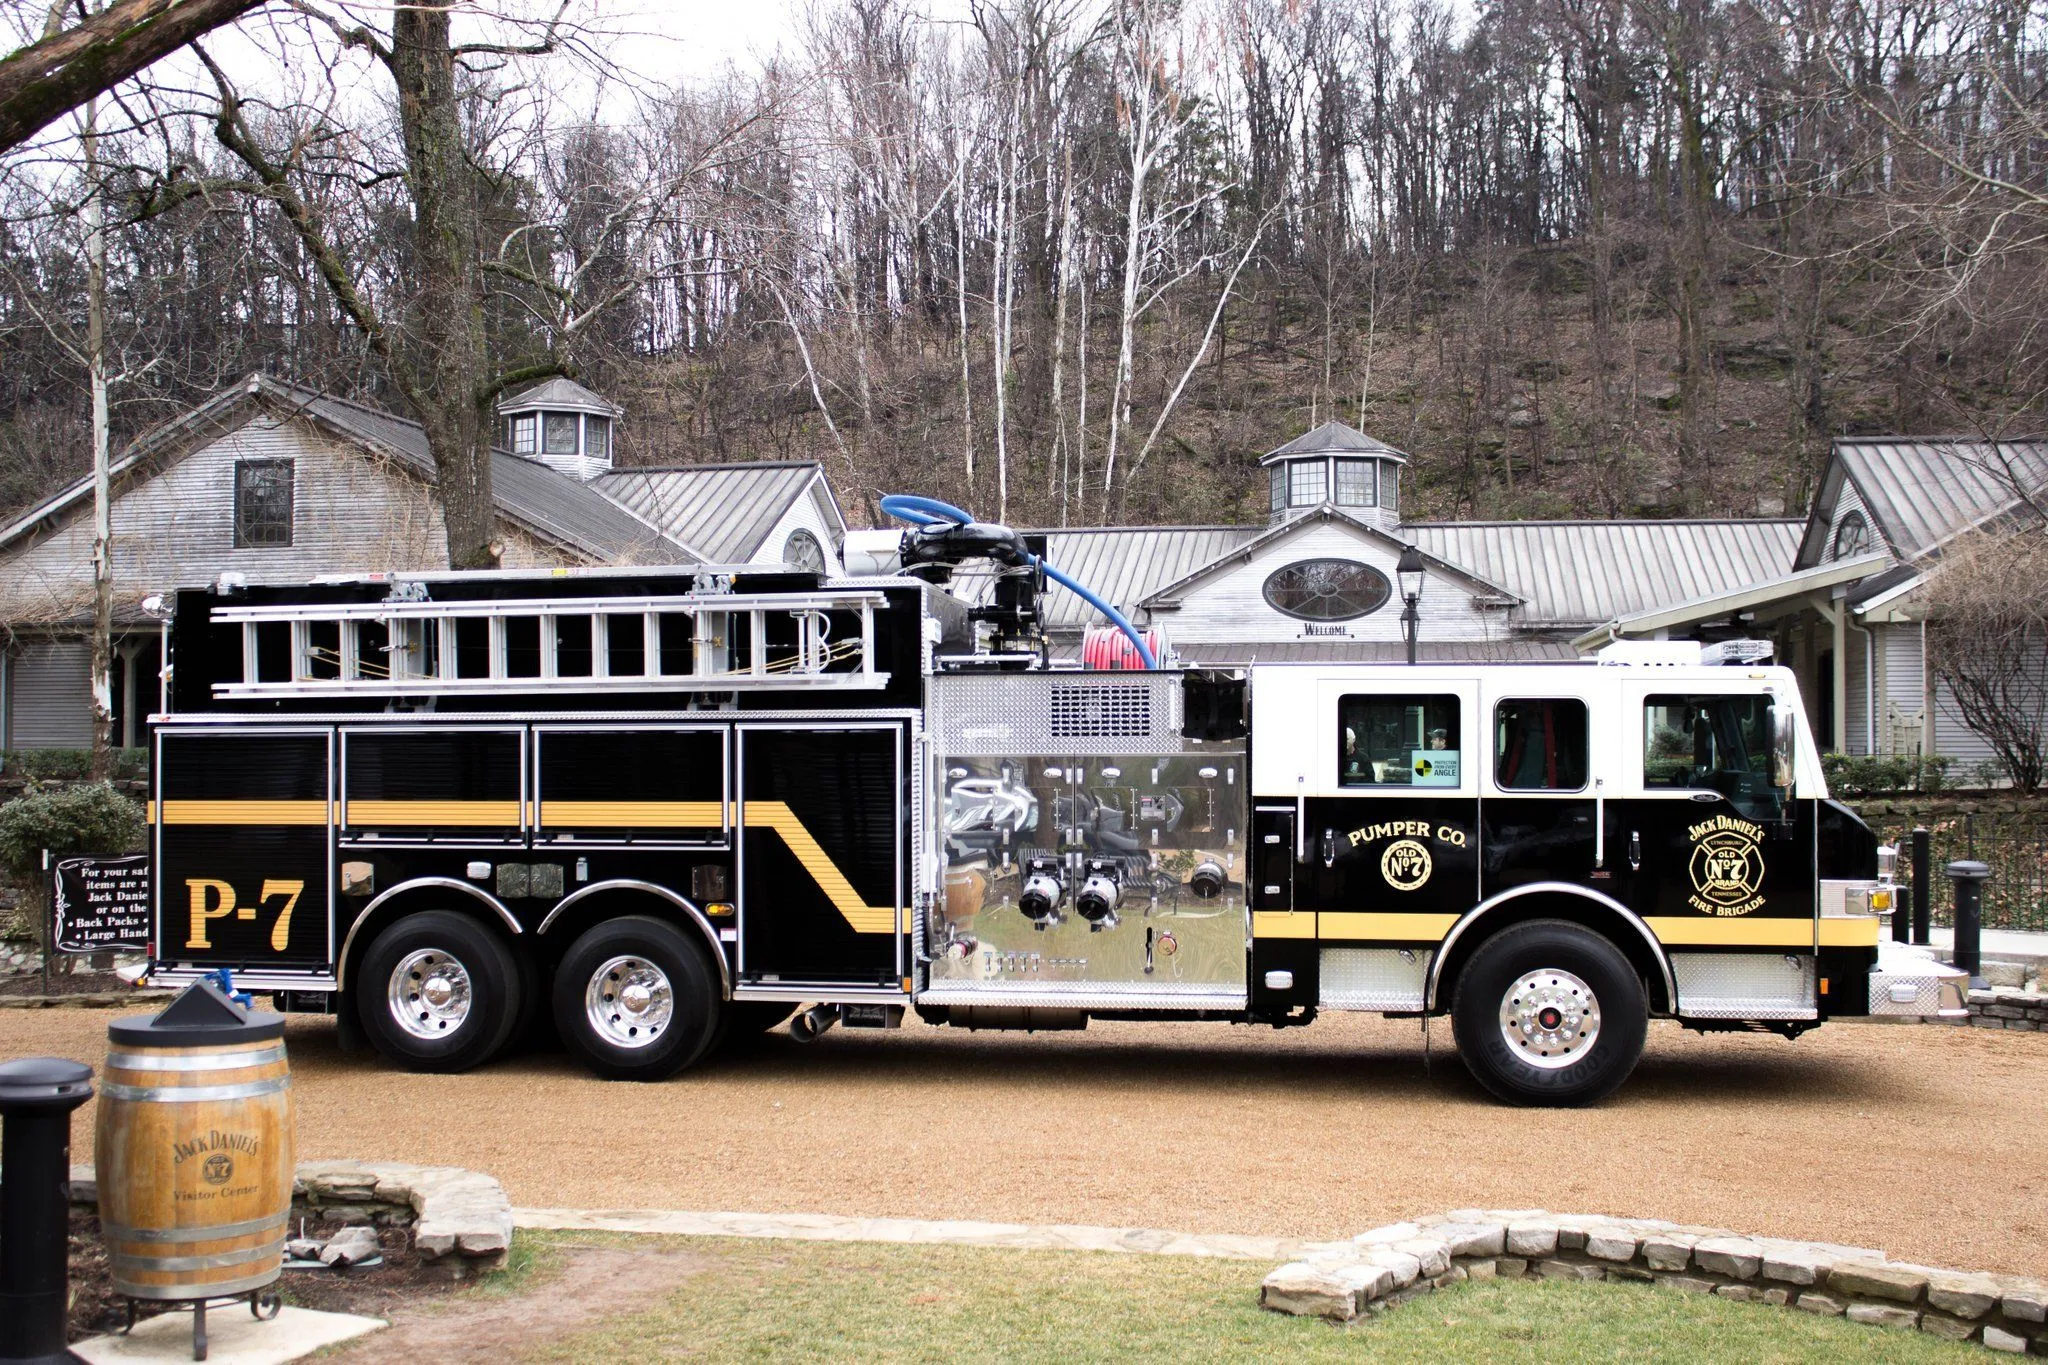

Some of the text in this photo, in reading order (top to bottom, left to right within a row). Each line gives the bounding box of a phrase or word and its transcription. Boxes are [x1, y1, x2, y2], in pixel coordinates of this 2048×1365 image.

[1304, 623, 1347, 636] WELCOME
[1347, 821, 1466, 848] PUMPER CO.
[1687, 815, 1765, 844] JACK DANIEL'S
[1395, 848, 1417, 857] OLD
[81, 868, 100, 878] For
[104, 868, 128, 878] your
[86, 880, 116, 890] items
[88, 891, 148, 902] Jack Danie
[111, 906, 125, 914] on
[129, 903, 147, 913] the
[1688, 895, 1766, 916] FIRE BRIGADE
[185, 879, 304, 951] P-7
[76, 916, 139, 928] Back Packs
[84, 928, 149, 940] Large Hand
[174, 1136, 208, 1164] JACK
[174, 1185, 259, 1201] Visitor Center
